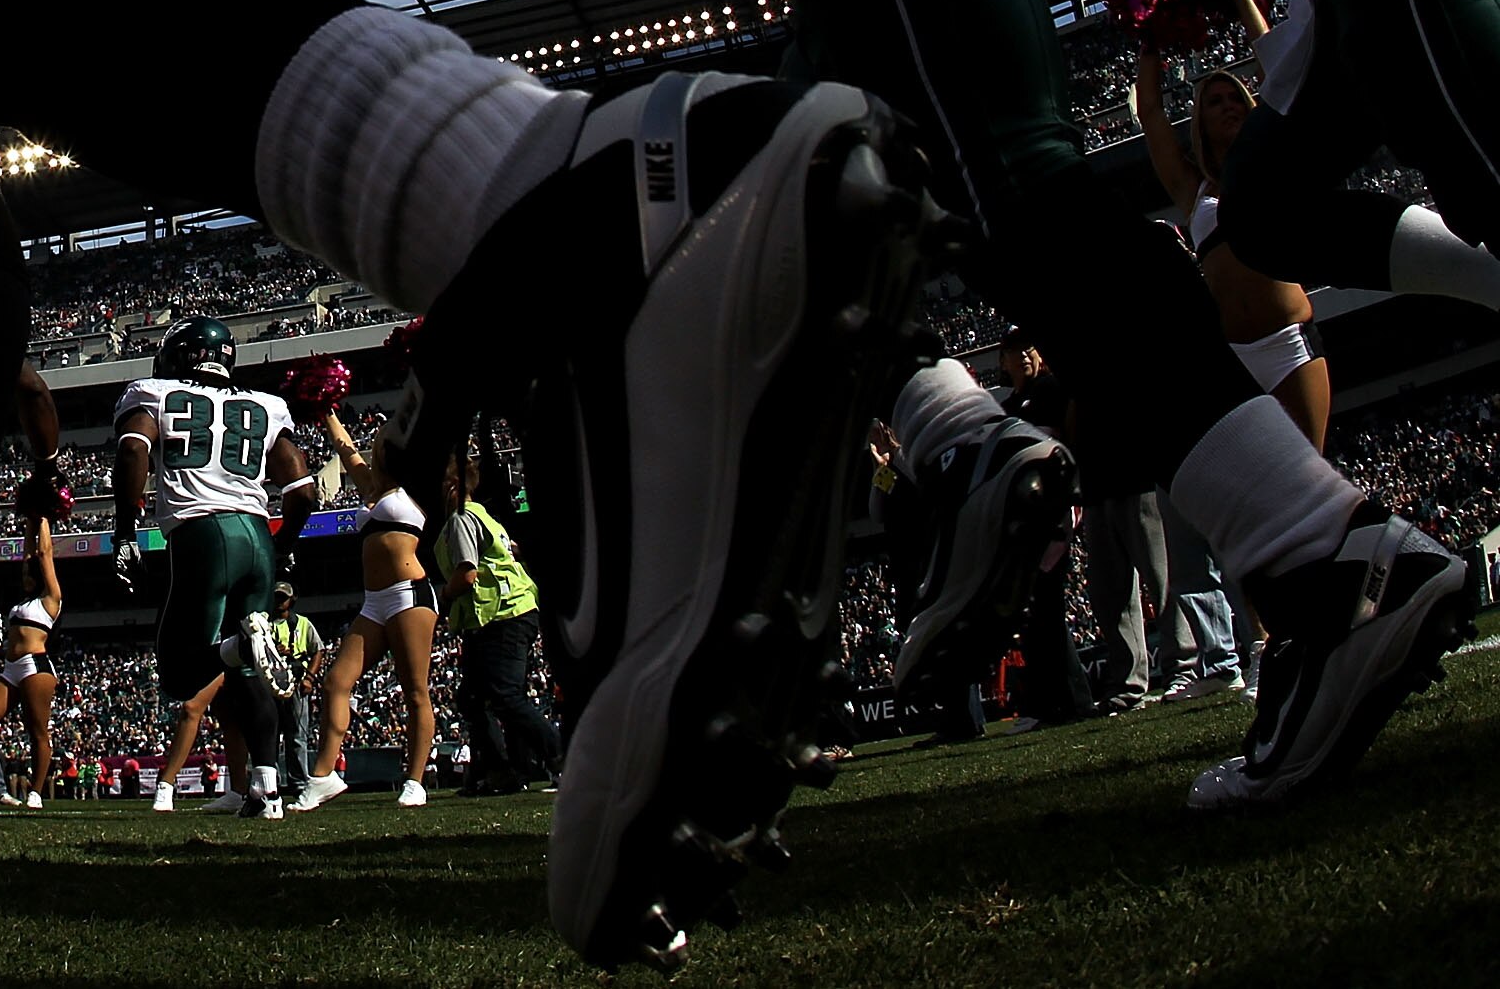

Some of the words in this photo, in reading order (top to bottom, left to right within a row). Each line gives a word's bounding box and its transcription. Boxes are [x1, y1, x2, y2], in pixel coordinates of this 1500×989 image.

[644, 141, 676, 202] NIKE
[163, 390, 269, 481] 38
[337, 513, 357, 522] FA
[861, 700, 895, 722] WE
